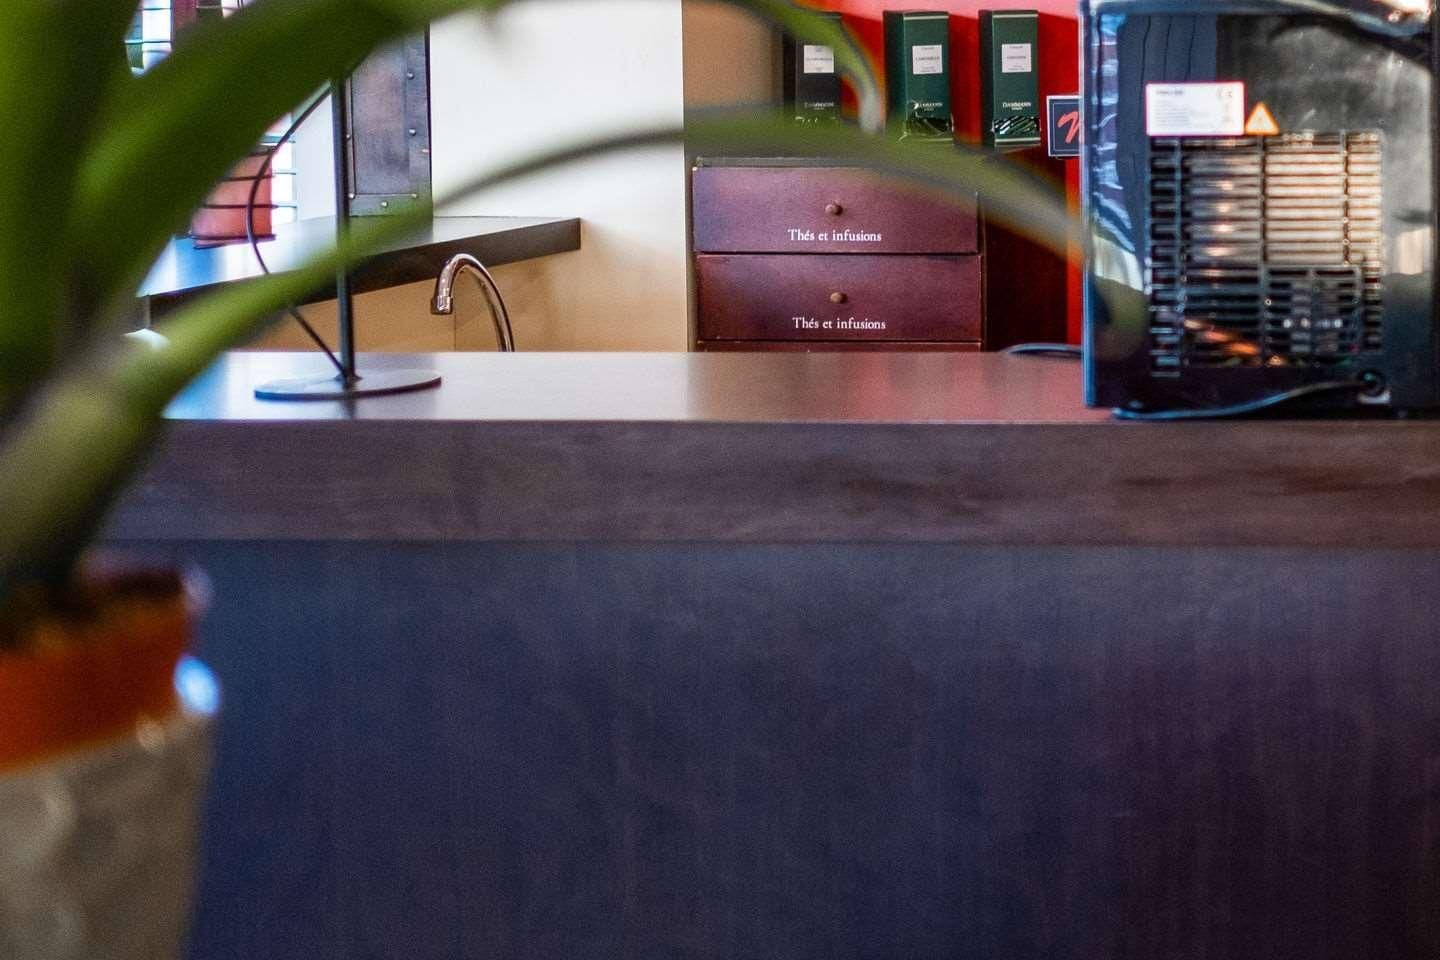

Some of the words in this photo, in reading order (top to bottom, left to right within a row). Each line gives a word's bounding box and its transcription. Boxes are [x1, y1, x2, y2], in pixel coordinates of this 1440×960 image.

[787, 228, 815, 241] Thés
[818, 232, 828, 241] et
[832, 228, 882, 242] infusions
[792, 316, 819, 329] Thés
[822, 320, 832, 329] et
[836, 316, 887, 330] infusions
